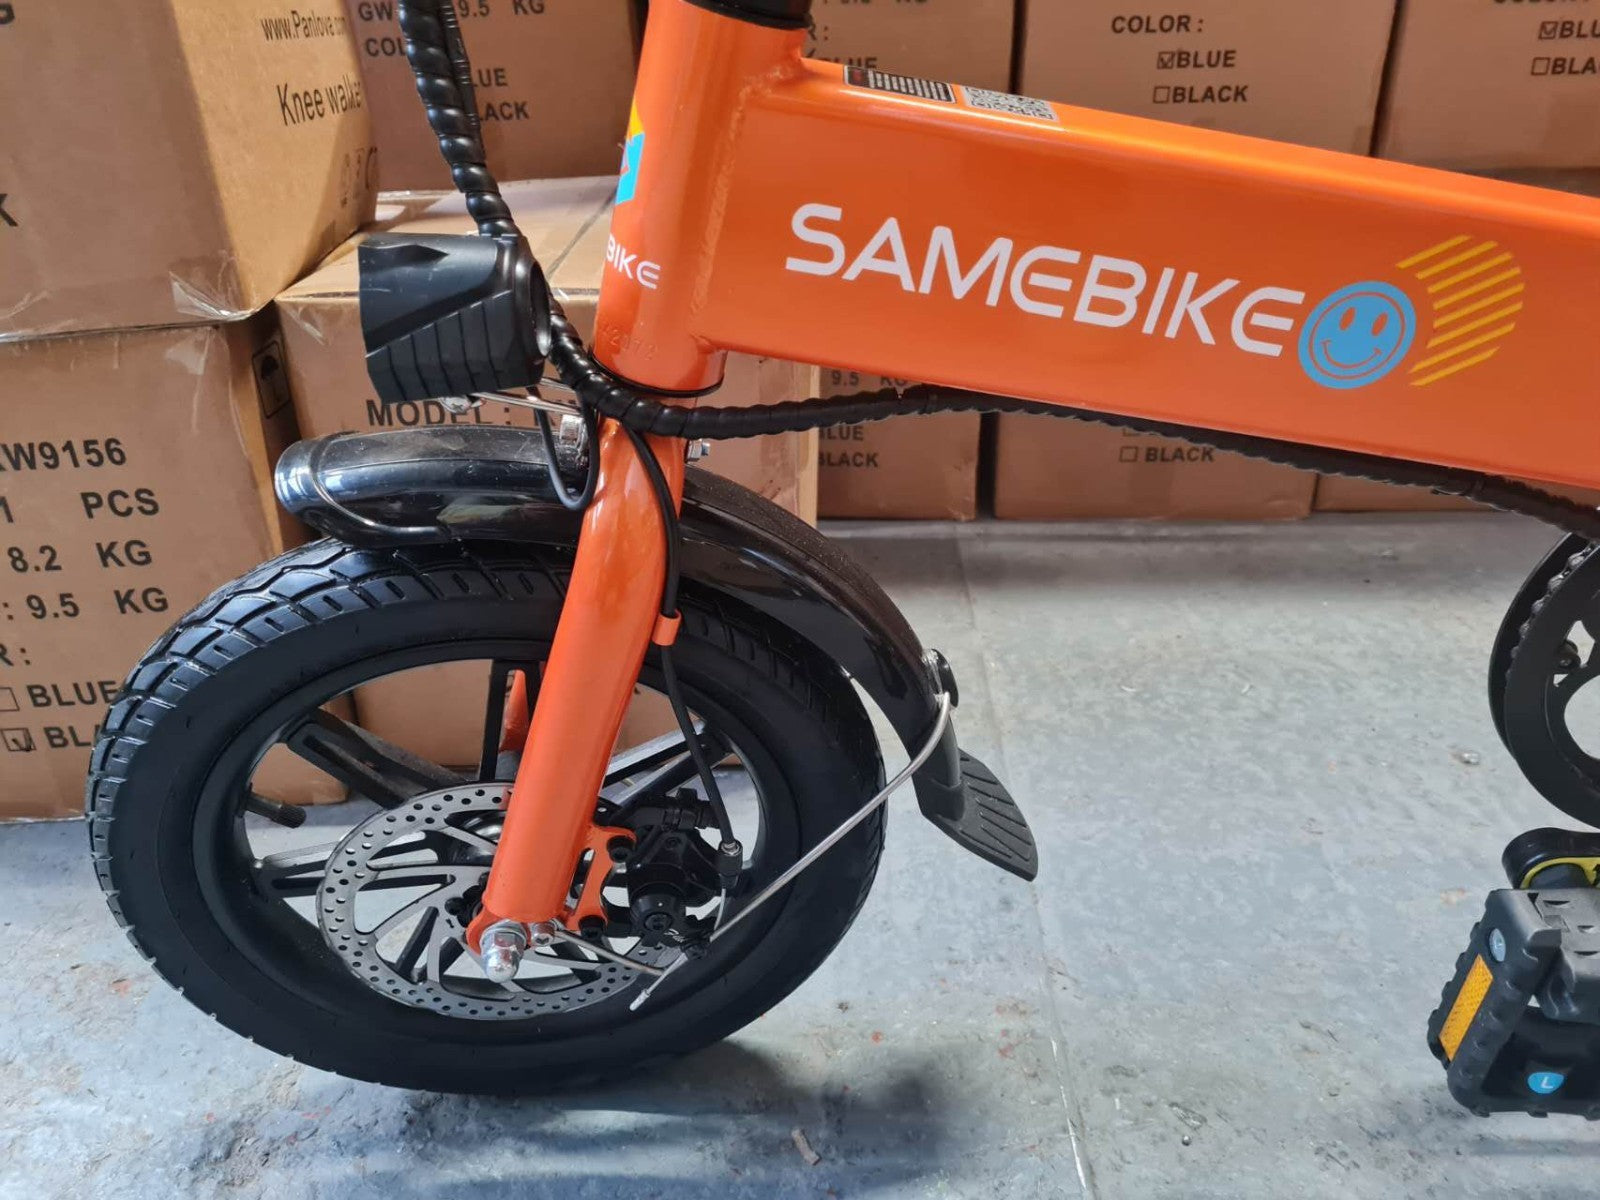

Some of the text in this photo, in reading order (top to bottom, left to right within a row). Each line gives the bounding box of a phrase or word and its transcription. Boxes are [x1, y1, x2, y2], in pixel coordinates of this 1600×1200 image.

[1175, 50, 1237, 69] BLUE
[276, 83, 325, 127] Knee
[1171, 85, 1249, 103] BLACK
[785, 202, 1307, 358] SAMEBIKE
[1144, 446, 1216, 463] BLACK
[80, 487, 160, 519] PCS
[7, 539, 153, 573] 8.2 KG
[26, 593, 80, 620] 9.5
[113, 587, 170, 615] KG
